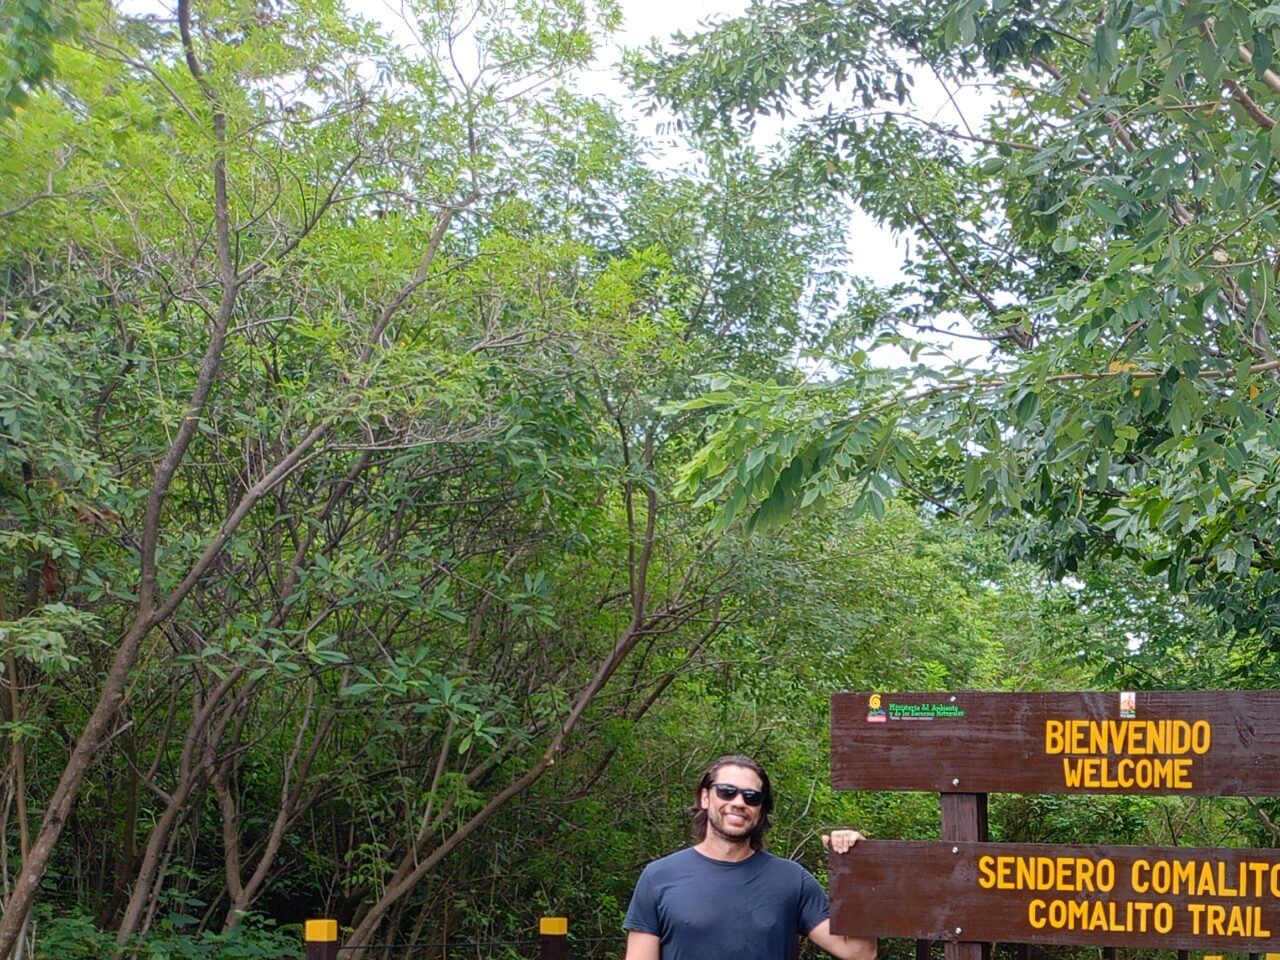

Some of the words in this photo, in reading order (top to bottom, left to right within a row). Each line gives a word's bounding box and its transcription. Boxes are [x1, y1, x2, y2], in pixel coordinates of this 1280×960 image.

[1045, 719, 1211, 755] BIENVENIDO
[1063, 757, 1193, 789] WELCOME
[978, 855, 1116, 893] SENDERO
[1028, 898, 1174, 934] COMALITO
[1187, 903, 1271, 938] TRAIL
